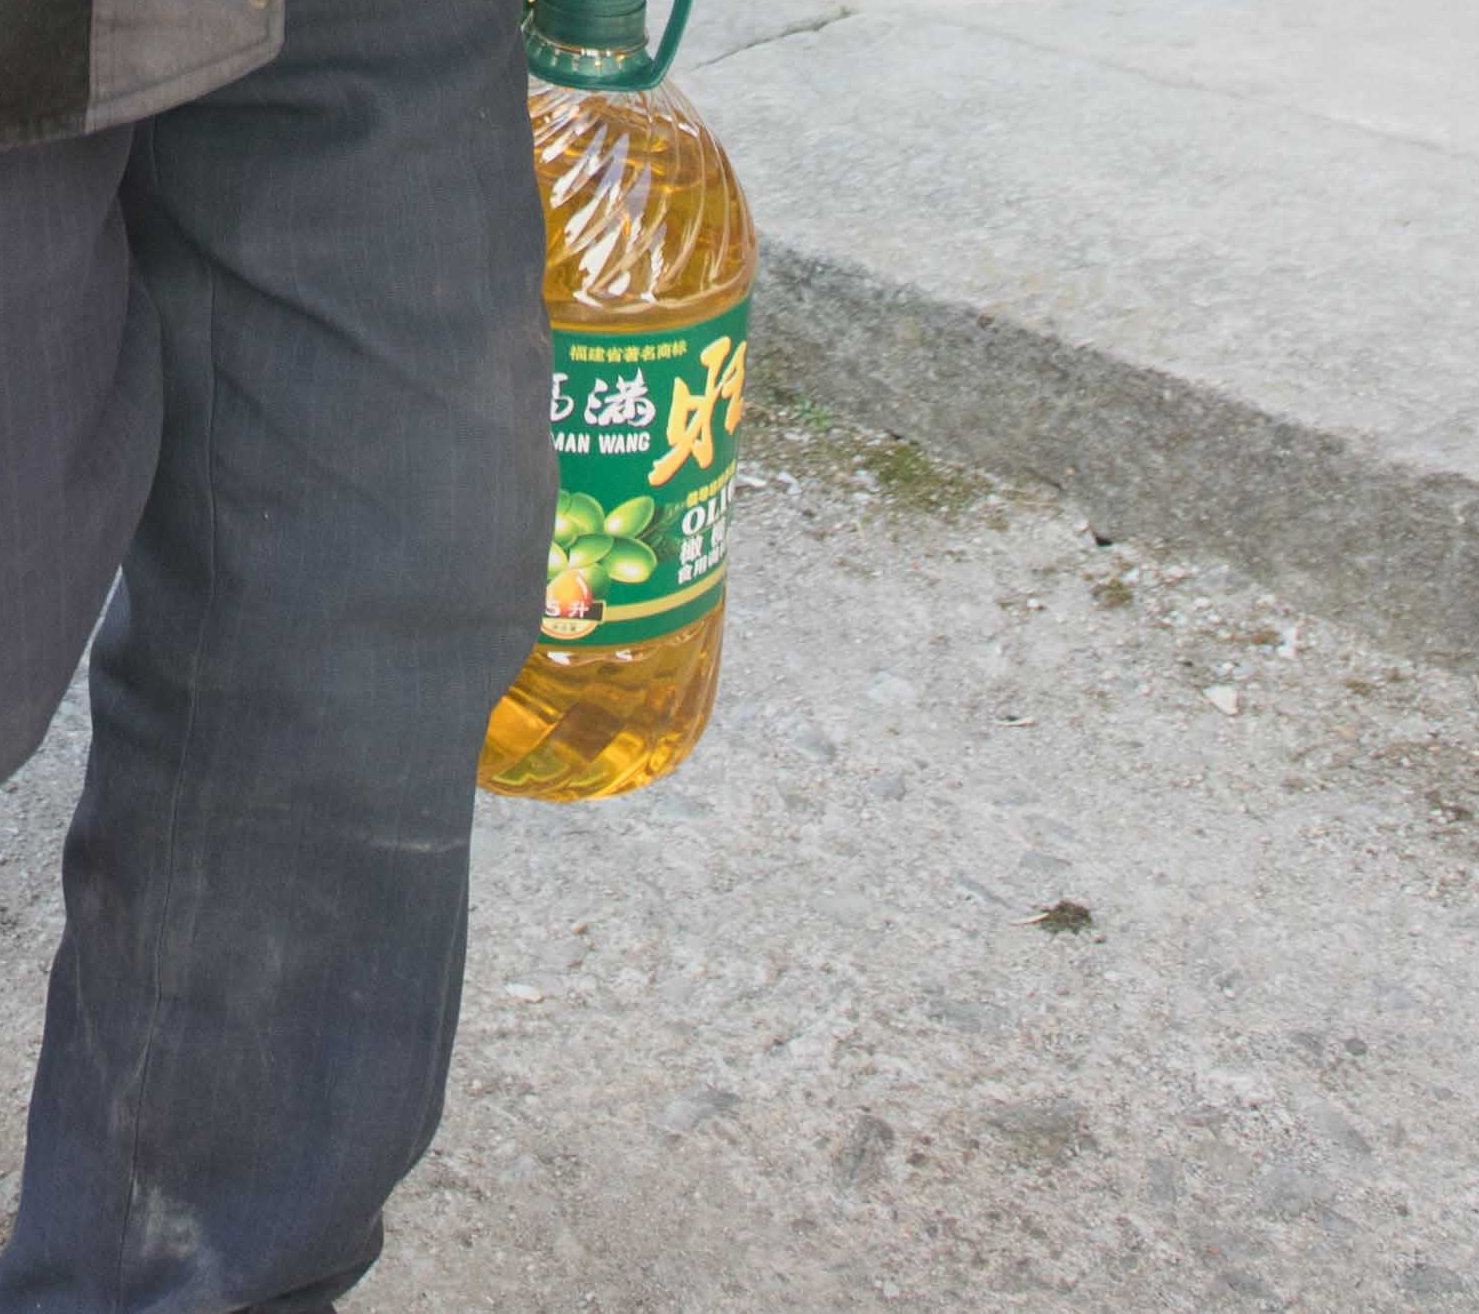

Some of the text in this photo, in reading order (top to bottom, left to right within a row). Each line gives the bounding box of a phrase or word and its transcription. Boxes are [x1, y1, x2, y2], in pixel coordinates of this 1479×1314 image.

[569, 339, 688, 363] 福建省著名商标
[599, 432, 651, 454] WANG
